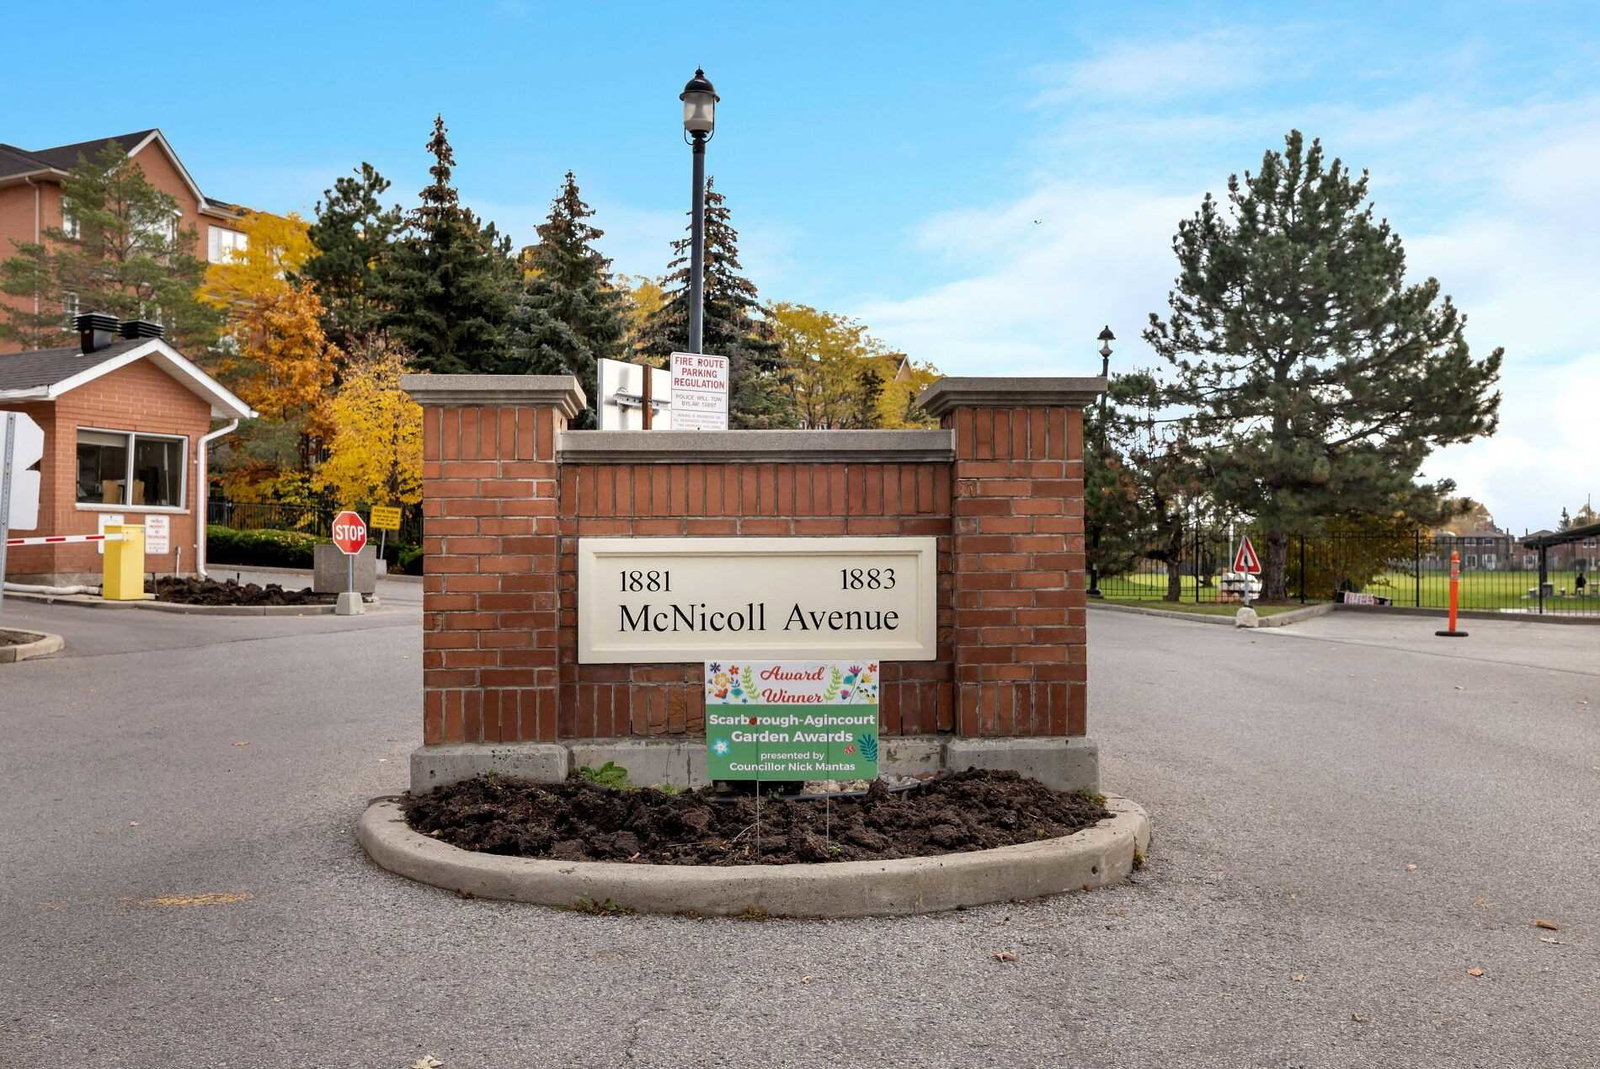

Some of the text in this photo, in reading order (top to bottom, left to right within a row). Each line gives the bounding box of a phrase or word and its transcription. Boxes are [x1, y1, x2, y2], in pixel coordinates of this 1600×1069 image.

[674, 356, 724, 368] FIRE ROUTE
[681, 368, 717, 378] PARKING
[674, 378, 725, 389] REGULATION
[335, 525, 364, 541] STOP
[620, 568, 896, 592] 1881 1883
[619, 602, 899, 632] McNicoll Avenue
[760, 665, 825, 681] Award
[761, 688, 823, 703] Winner
[709, 714, 875, 728] Scarbrough-Agincourt
[731, 730, 853, 743] Garden Awards
[760, 751, 824, 761] presented by
[729, 762, 856, 771] Councillor Nick Mantas
